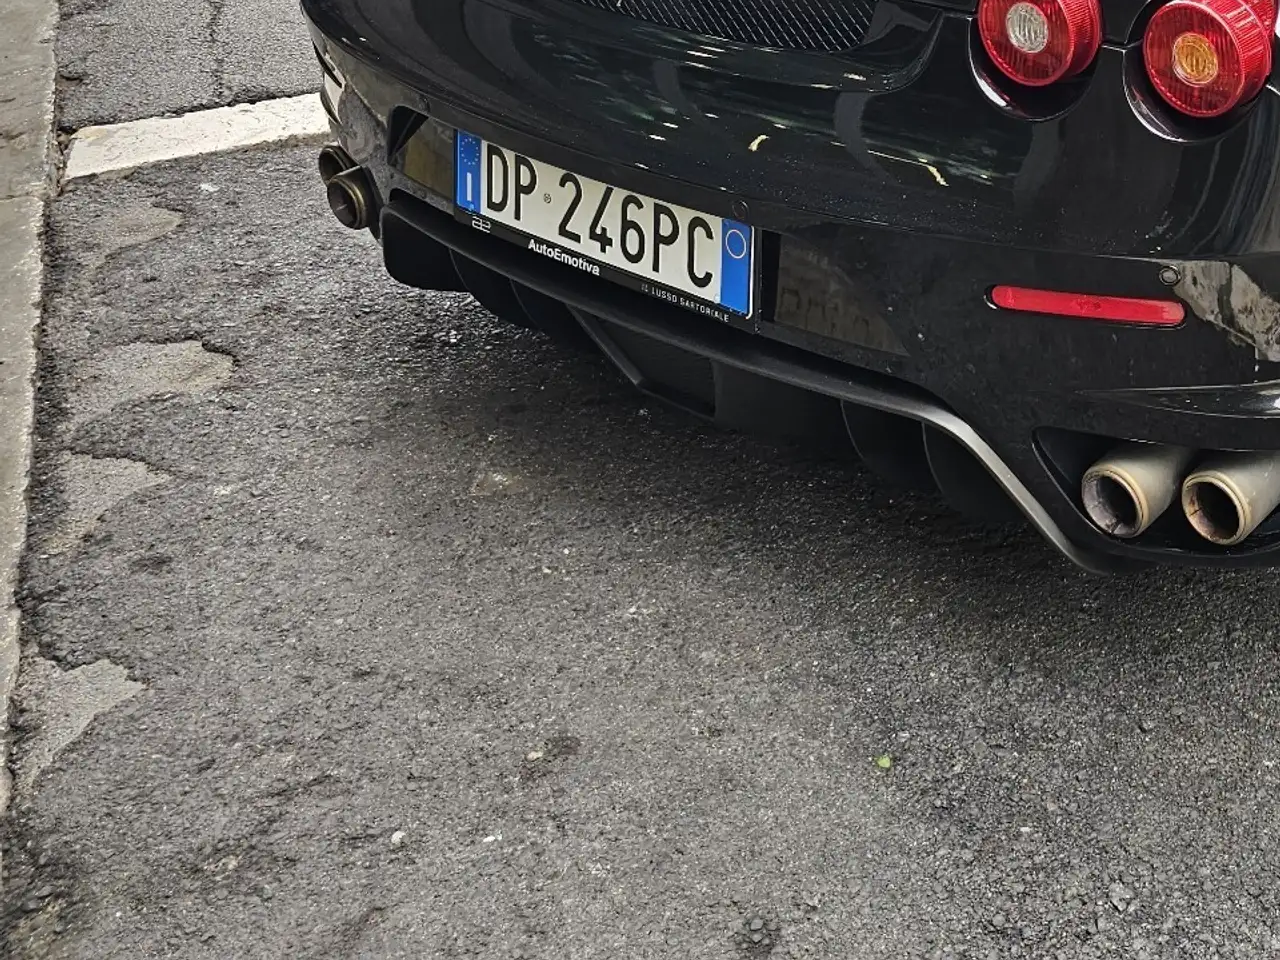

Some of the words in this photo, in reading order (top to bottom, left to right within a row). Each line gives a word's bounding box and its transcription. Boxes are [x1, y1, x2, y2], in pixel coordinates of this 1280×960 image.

[487, 143, 537, 221] DP
[558, 172, 714, 288] 246PC
[528, 239, 600, 276] AutoEmotiva
[651, 288, 678, 303] LUSSO
[679, 297, 730, 323] SARTORIALE
